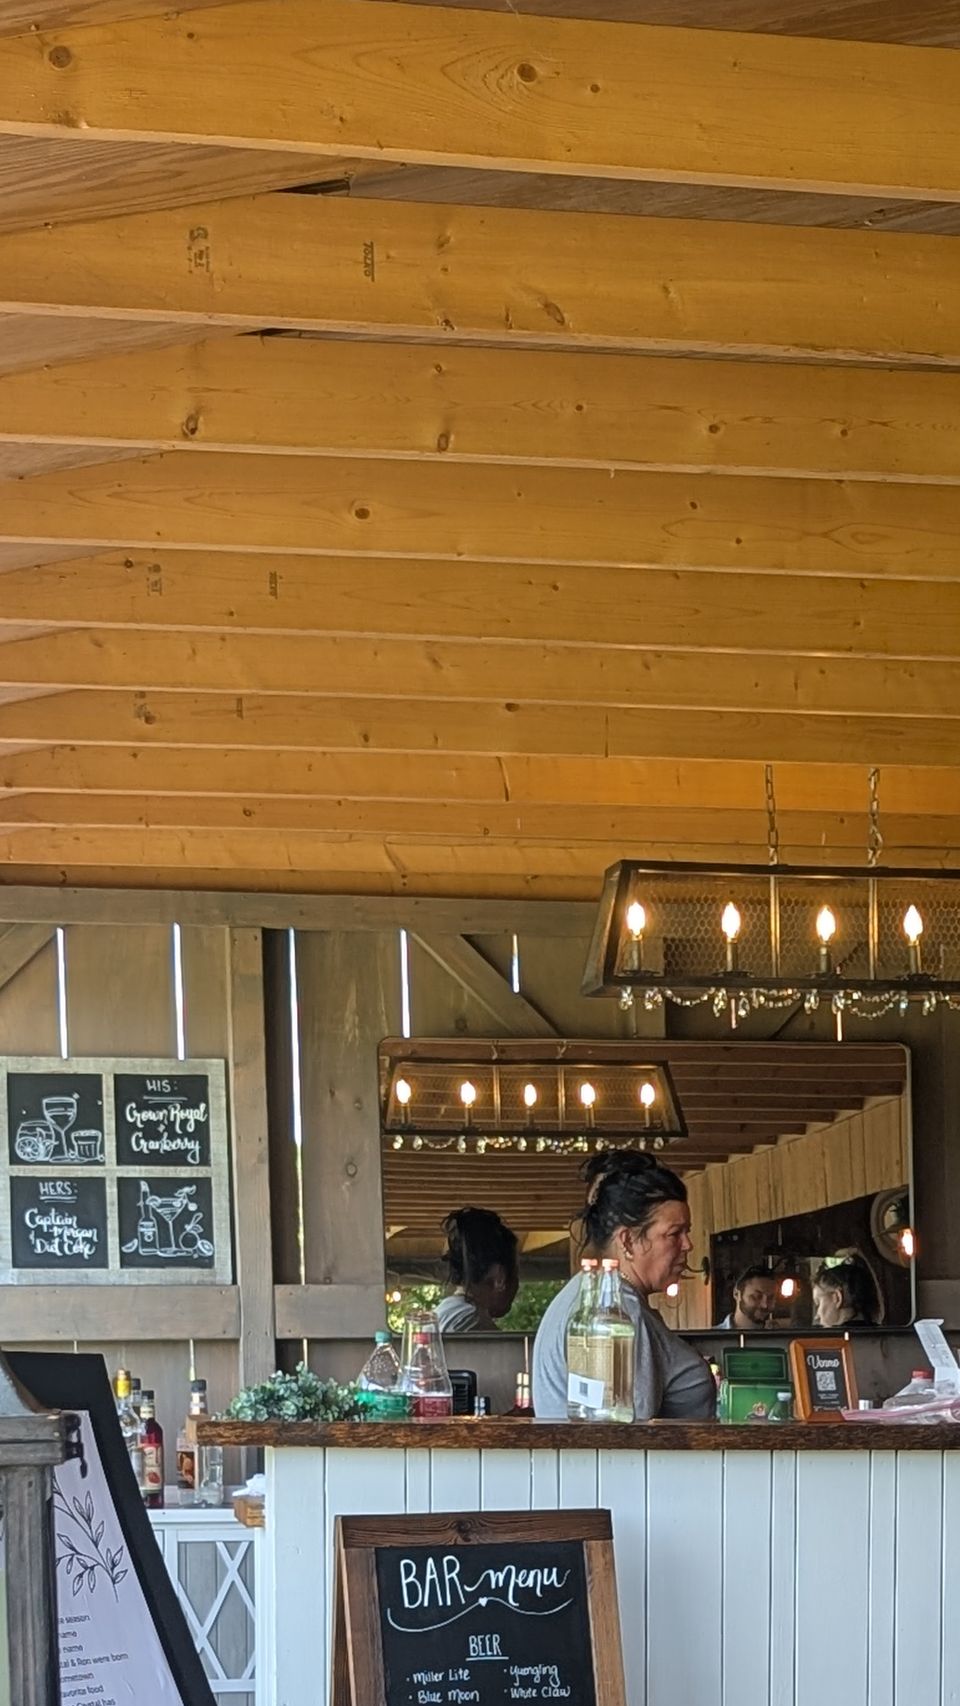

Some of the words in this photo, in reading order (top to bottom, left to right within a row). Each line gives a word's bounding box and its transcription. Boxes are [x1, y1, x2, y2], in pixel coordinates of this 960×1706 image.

[126, 1102, 168, 1128] Crown
[167, 1102, 208, 1134] Royal
[131, 1132, 201, 1165] Cranberry
[39, 1181, 79, 1195] HERS:
[25, 1208, 78, 1232] Captain
[49, 1226, 98, 1243] Morgan
[34, 1238, 63, 1256] Diet
[400, 1555, 466, 1608] BAR
[468, 1633, 502, 1656] BEER
[448, 1667, 471, 1681] Lite
[87, 1685, 104, 1694] food
[417, 1689, 443, 1704] Blue
[447, 1688, 479, 1704] Moon
[510, 1687, 538, 1699] White
[541, 1685, 571, 1698] Claw
